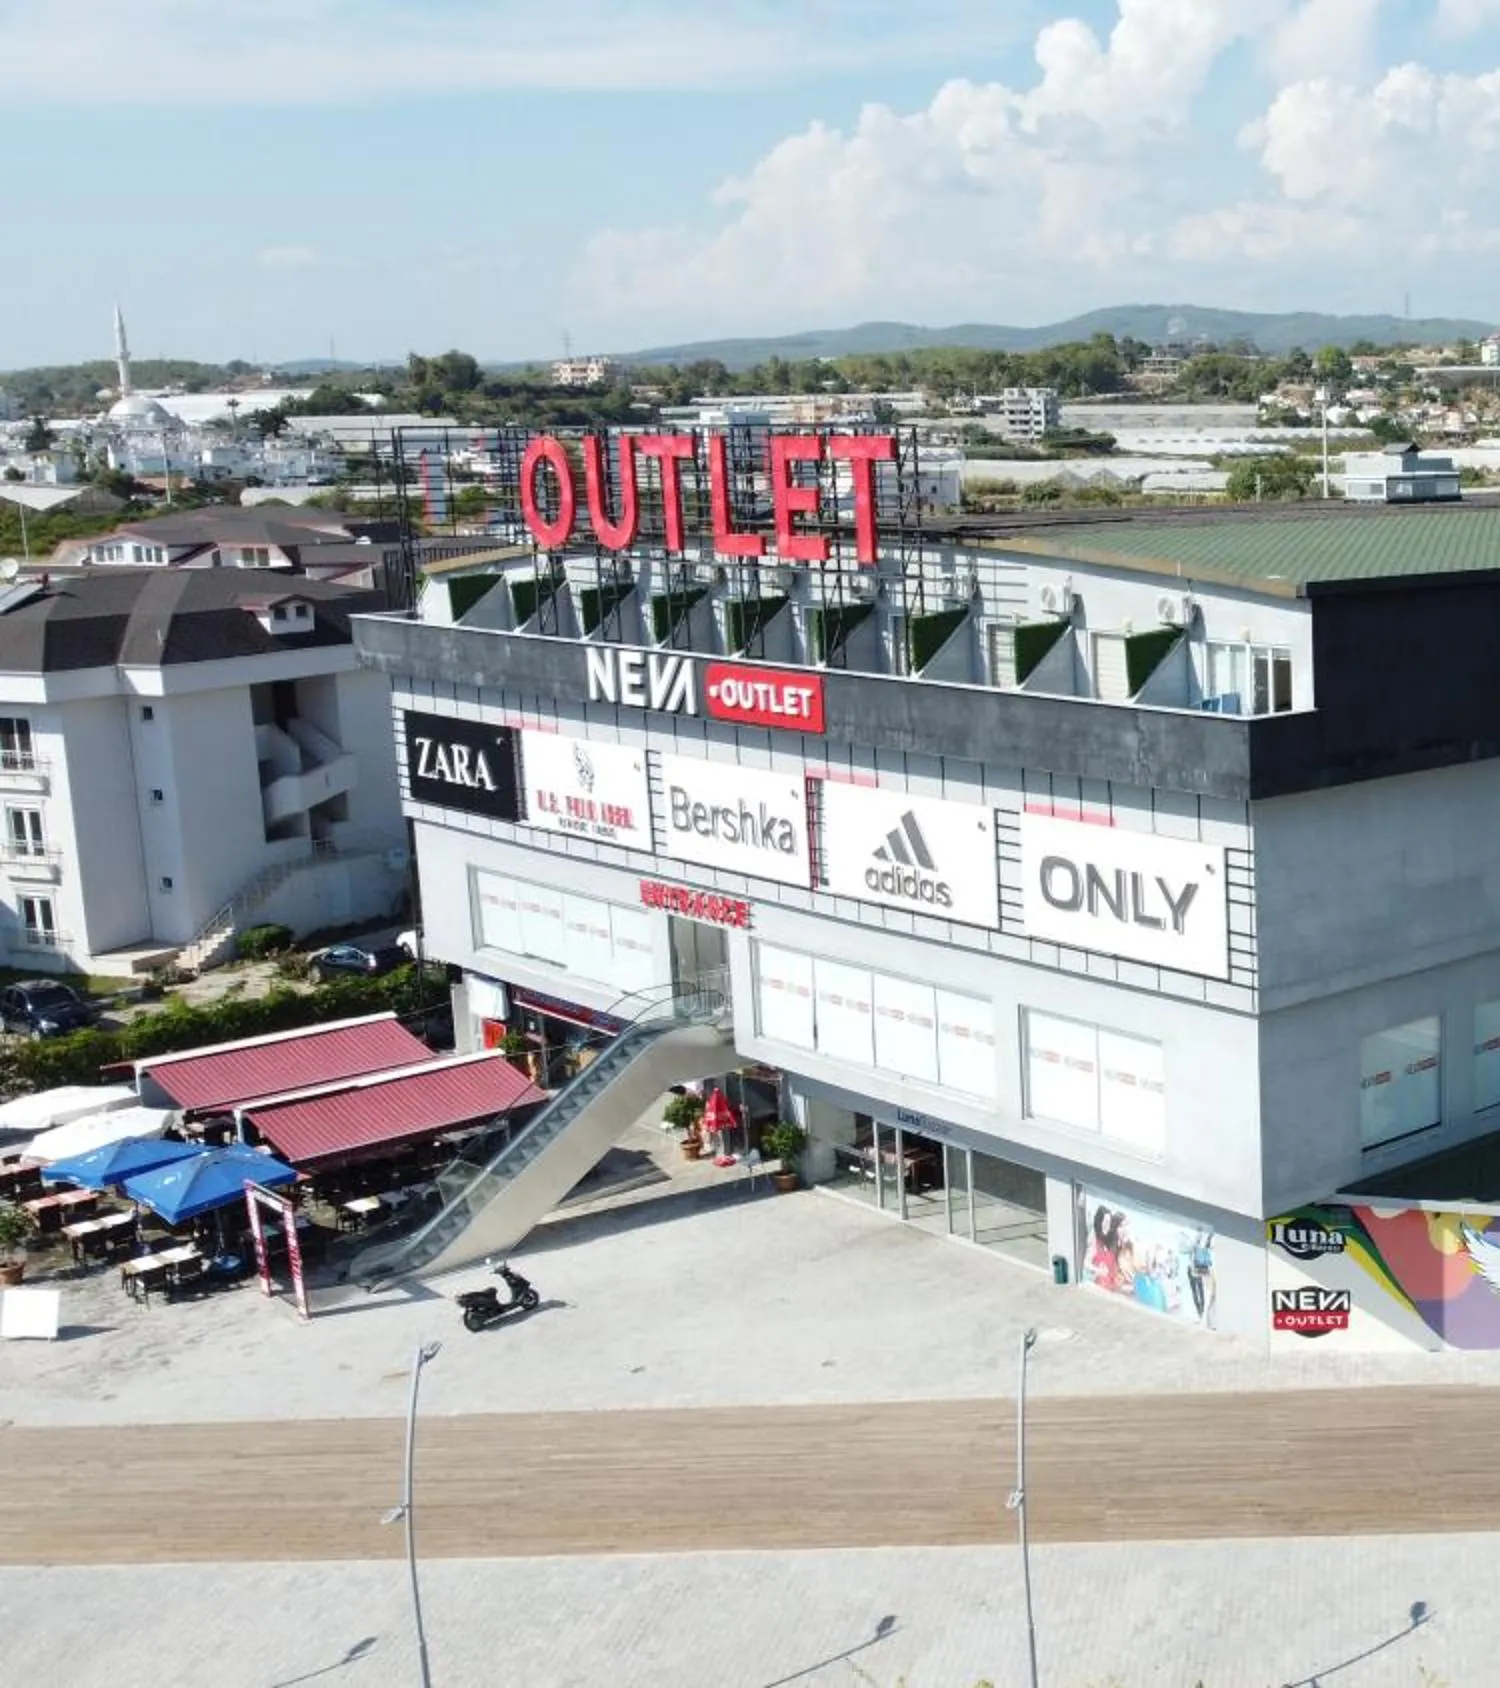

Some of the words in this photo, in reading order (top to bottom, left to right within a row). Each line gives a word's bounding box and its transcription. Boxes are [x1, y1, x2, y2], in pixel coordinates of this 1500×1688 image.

[520, 434, 898, 566] OUTLET
[585, 648, 698, 715] NEVA
[720, 678, 815, 719] OUTLET
[415, 736, 498, 792] ZARA
[669, 784, 799, 856] Bershka
[865, 864, 953, 908] adidas
[1039, 854, 1199, 936] ONLY
[1275, 1290, 1350, 1311] NEVA
[1284, 1315, 1344, 1327] OUTLET
